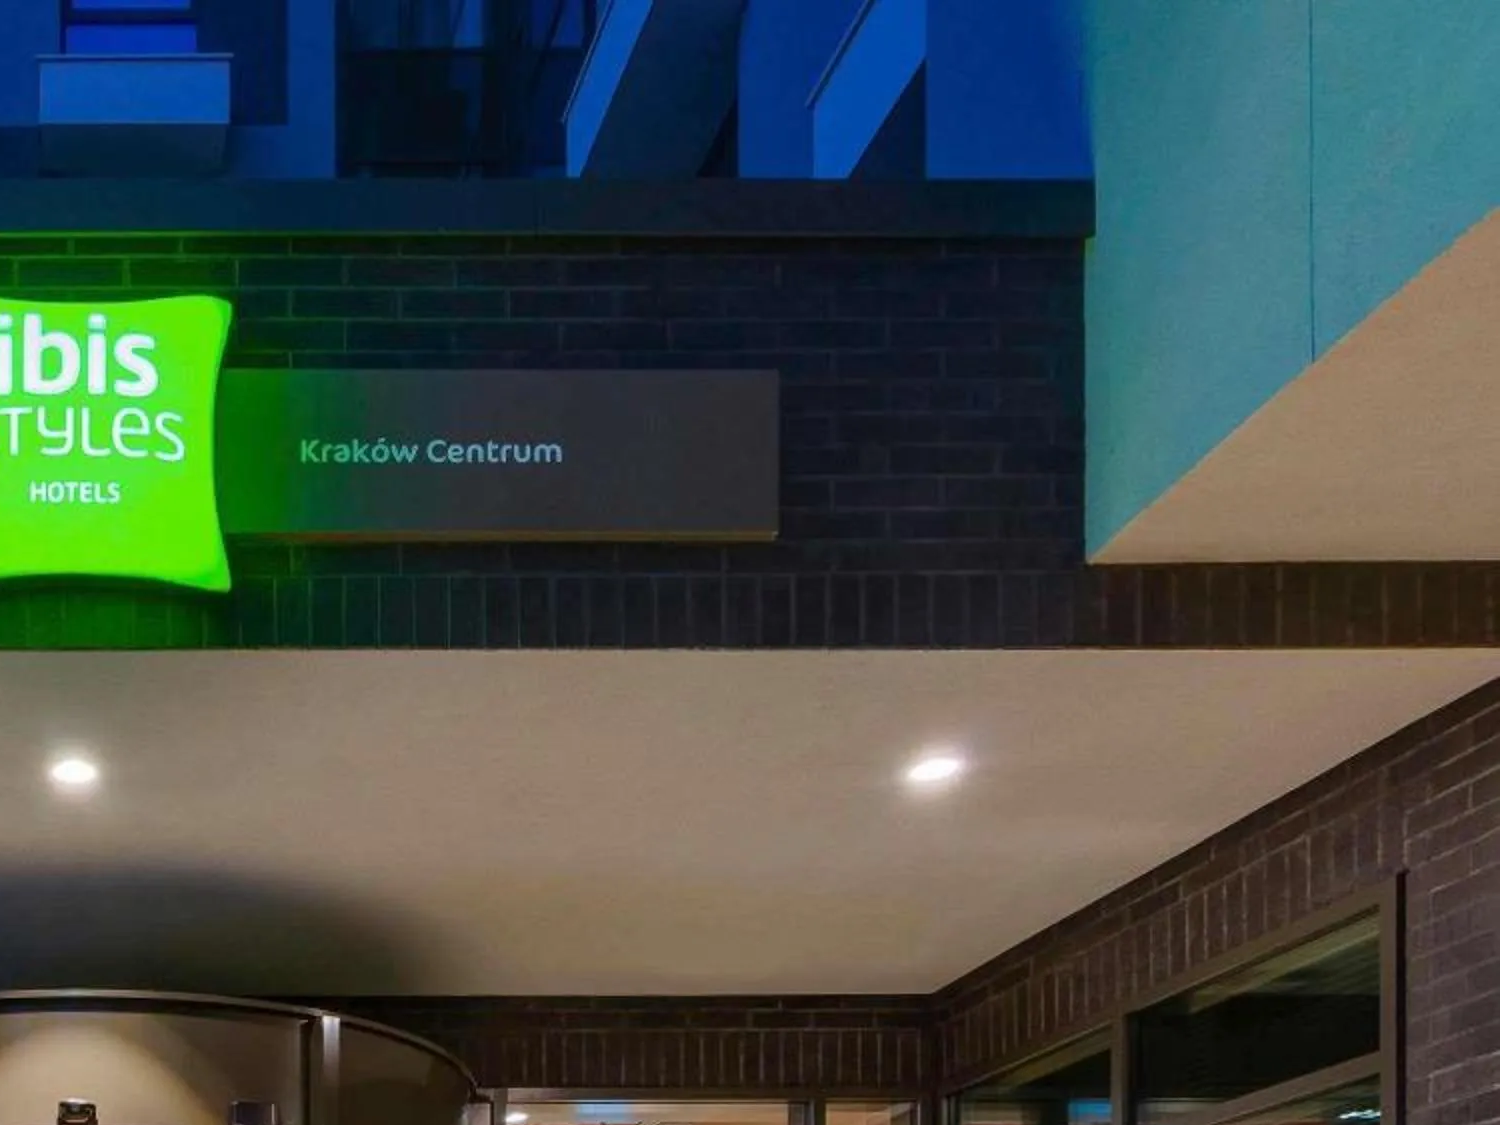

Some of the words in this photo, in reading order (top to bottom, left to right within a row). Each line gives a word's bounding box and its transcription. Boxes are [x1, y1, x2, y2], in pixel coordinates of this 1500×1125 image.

[300, 438, 418, 464] Kraków
[426, 440, 563, 464] Centrum
[29, 481, 121, 503] HOTELS
